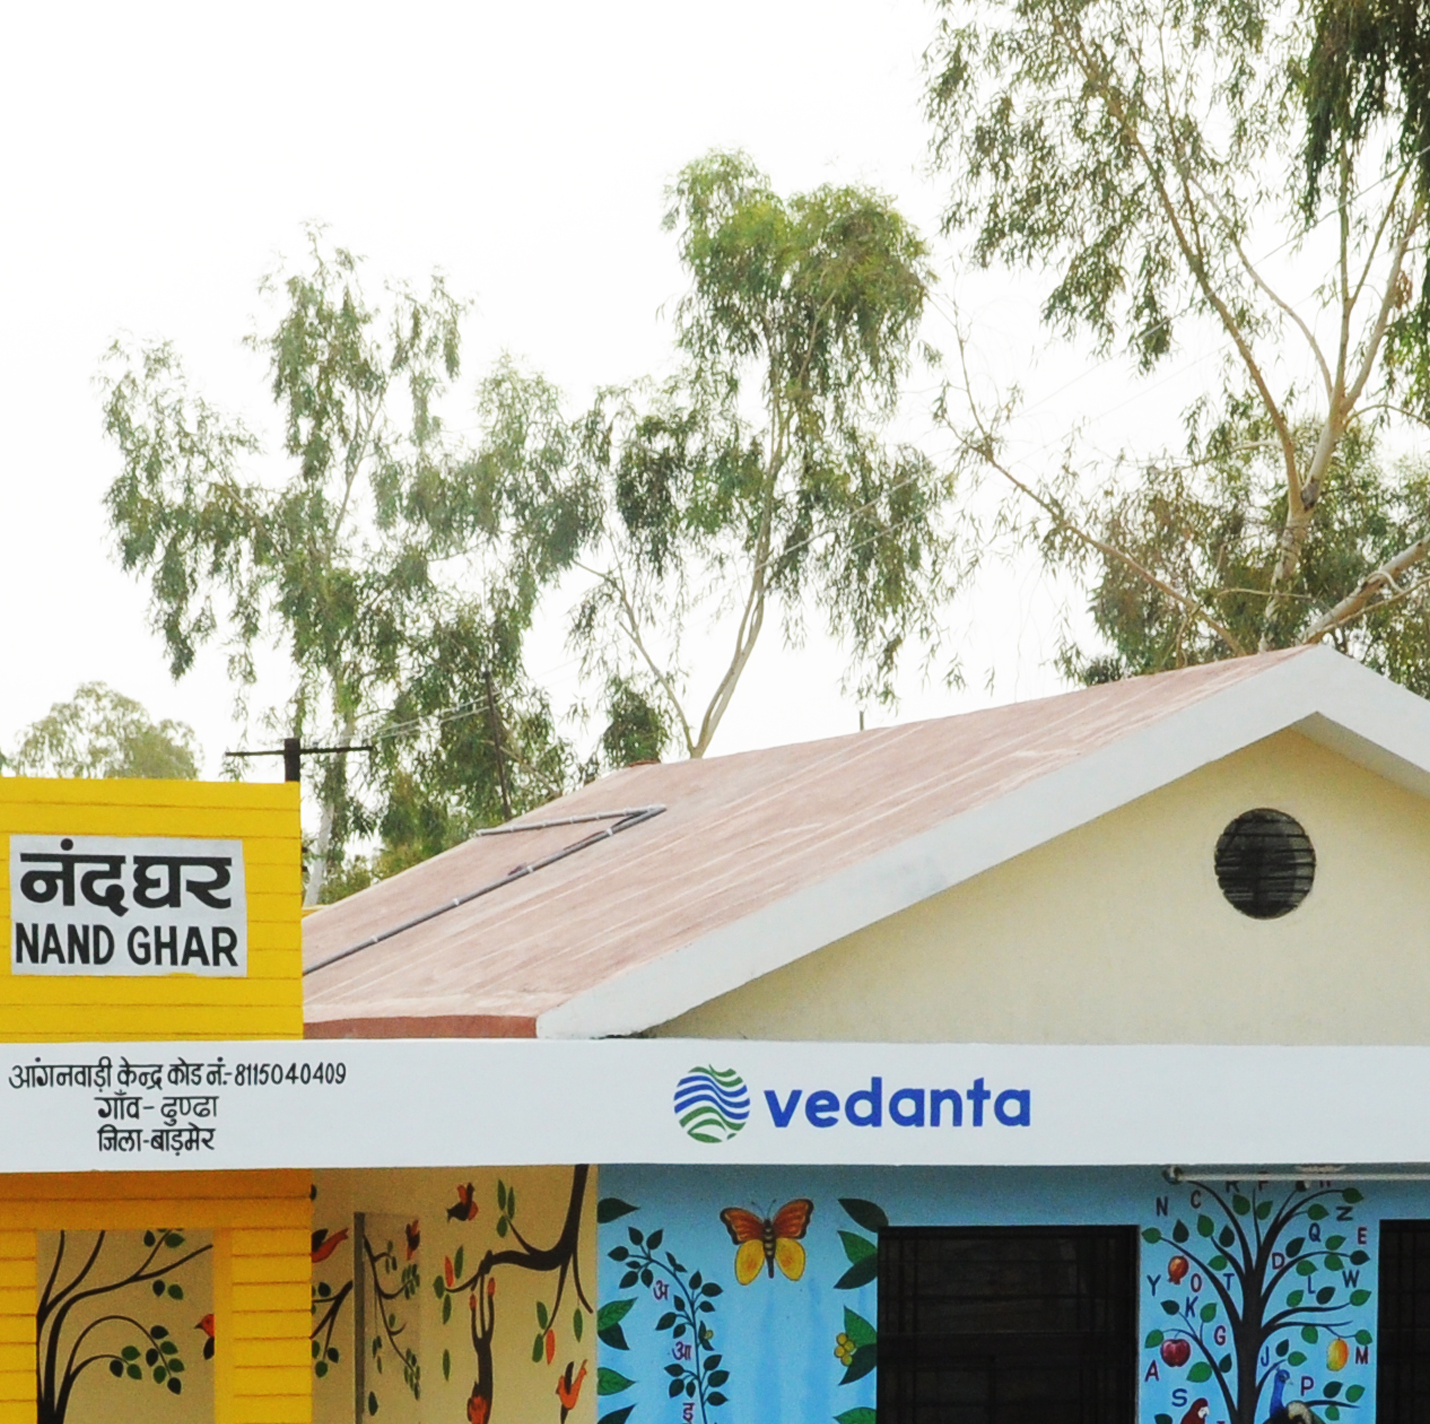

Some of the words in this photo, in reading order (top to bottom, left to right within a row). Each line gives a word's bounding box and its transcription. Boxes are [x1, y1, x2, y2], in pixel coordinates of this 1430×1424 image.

[15, 922, 115, 965] NAND
[127, 925, 238, 967] GHAR
[8, 1055, 113, 1093] आंगनवाड़ी
[117, 1056, 164, 1092] केन्द्र
[167, 1056, 205, 1086] कोड
[763, 1076, 1031, 1128] vedanta
[1156, 1197, 1167, 1216] N
[1191, 1190, 1201, 1209] C
[1308, 1223, 1320, 1242] Q
[1357, 1227, 1367, 1244] E
[1272, 1252, 1285, 1269] D
[1147, 1275, 1161, 1296] Y
[1223, 1273, 1235, 1291] T
[1308, 1275, 1316, 1294] L
[1342, 1270, 1360, 1288] W
[1185, 1296, 1198, 1318] K
[1214, 1326, 1226, 1345] G
[1260, 1347, 1270, 1367] J
[1355, 1347, 1369, 1364] M
[1144, 1360, 1160, 1382] A
[1301, 1376, 1314, 1396] P
[1172, 1388, 1188, 1406] S
